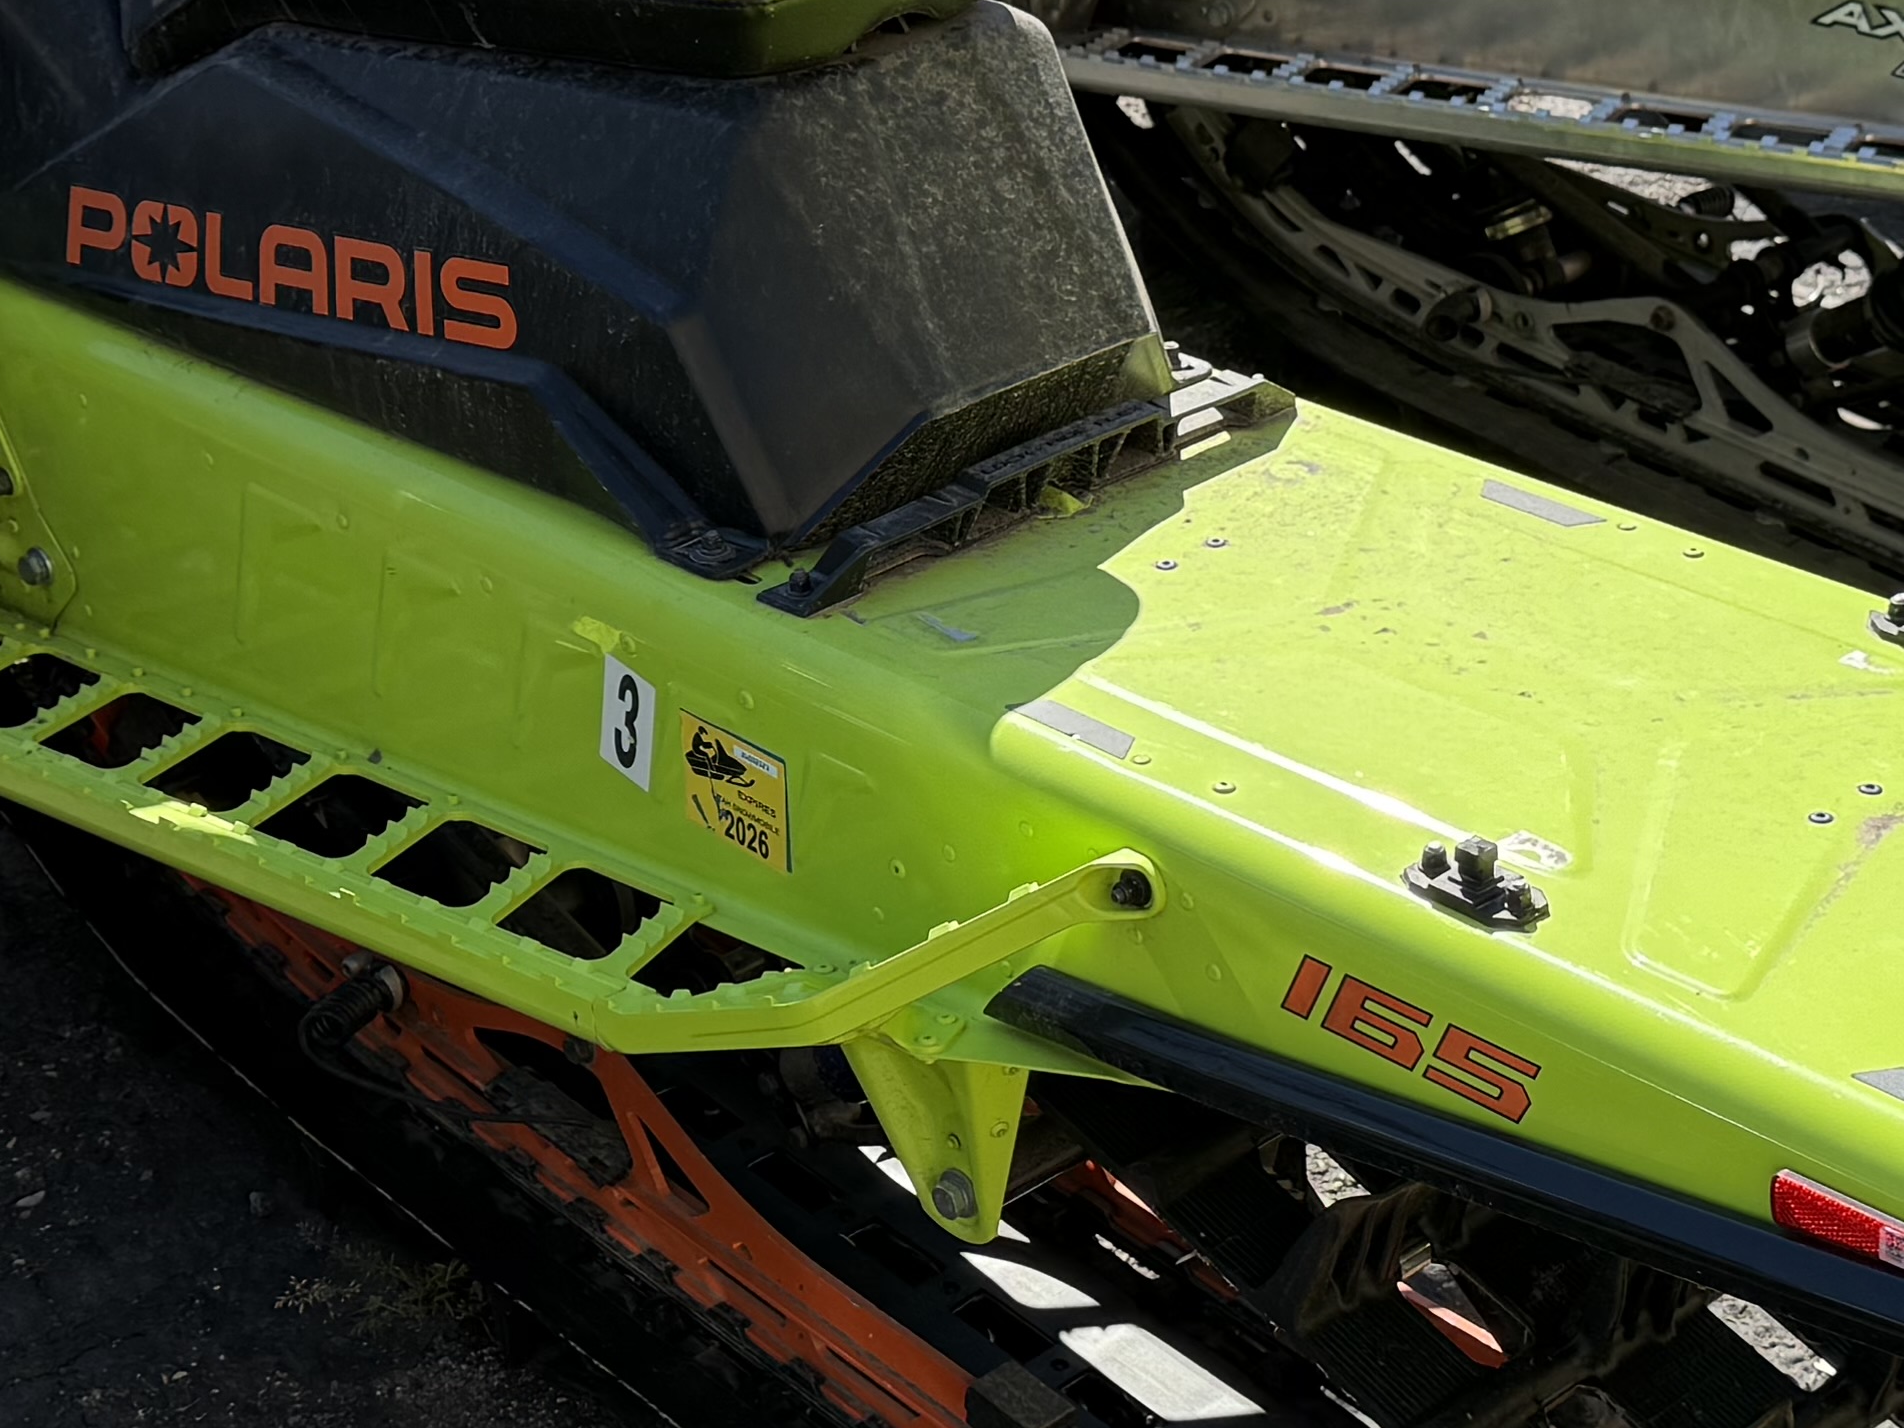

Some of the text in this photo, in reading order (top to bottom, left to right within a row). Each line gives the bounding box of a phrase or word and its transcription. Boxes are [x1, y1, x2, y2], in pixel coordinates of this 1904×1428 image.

[65, 184, 519, 351] POLARIS
[614, 673, 640, 769] 3
[724, 809, 770, 860] 2026
[737, 789, 777, 819] EXPIRES
[1280, 953, 1542, 1125] 165
